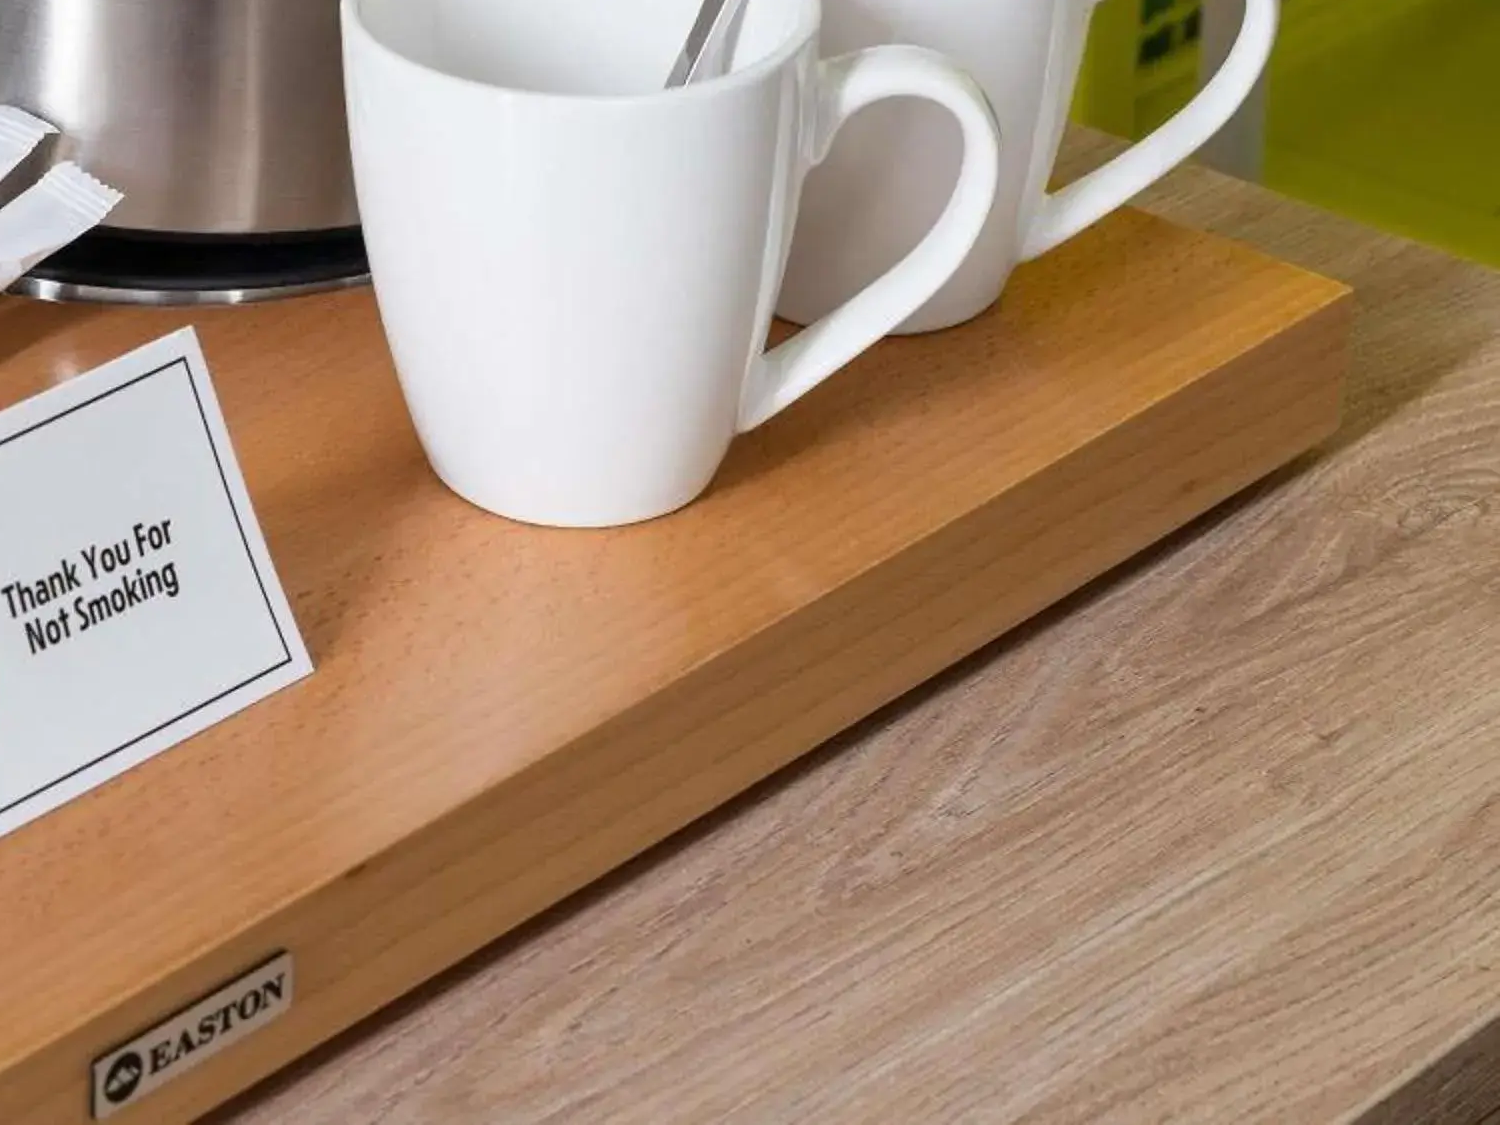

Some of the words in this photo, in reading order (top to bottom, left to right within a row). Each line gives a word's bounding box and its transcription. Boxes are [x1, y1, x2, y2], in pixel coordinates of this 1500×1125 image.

[0, 559, 81, 618] Thank
[80, 538, 131, 580] You
[132, 519, 171, 557] For
[23, 607, 71, 655] Not
[73, 561, 180, 632] Smoking
[148, 972, 286, 1076] EASTON
